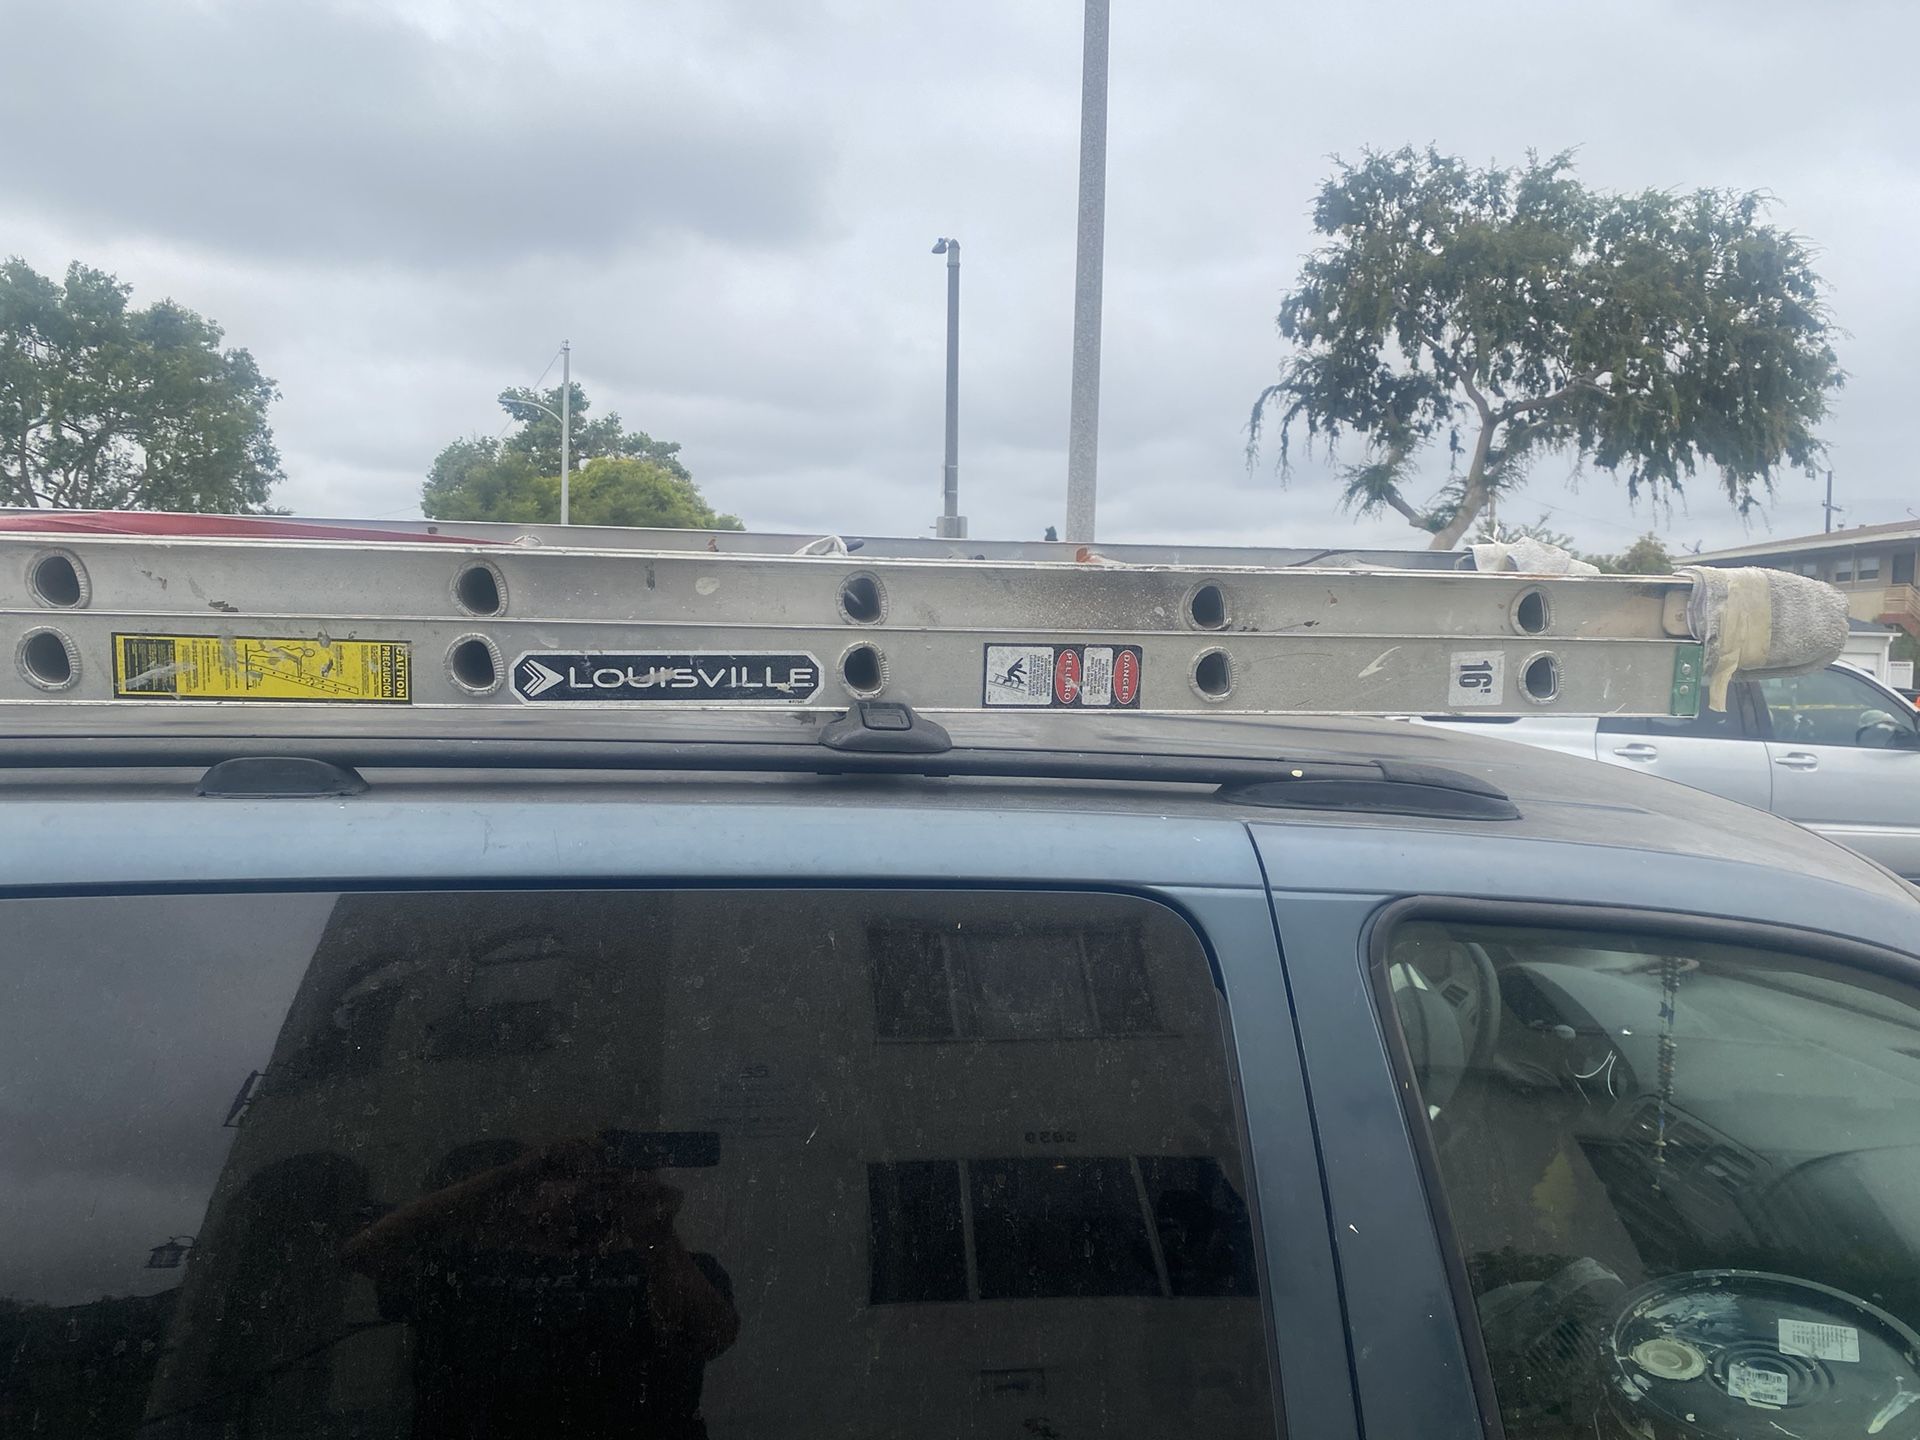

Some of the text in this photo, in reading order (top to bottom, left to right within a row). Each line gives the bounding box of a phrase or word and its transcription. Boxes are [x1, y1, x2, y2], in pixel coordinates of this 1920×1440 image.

[382, 645, 393, 697] PRECAUCIÓN
[395, 646, 405, 697] CAUTION
[568, 665, 815, 689] LOUISVILLE
[1064, 653, 1072, 700] PELIGRO
[1122, 654, 1130, 700] DANGER
